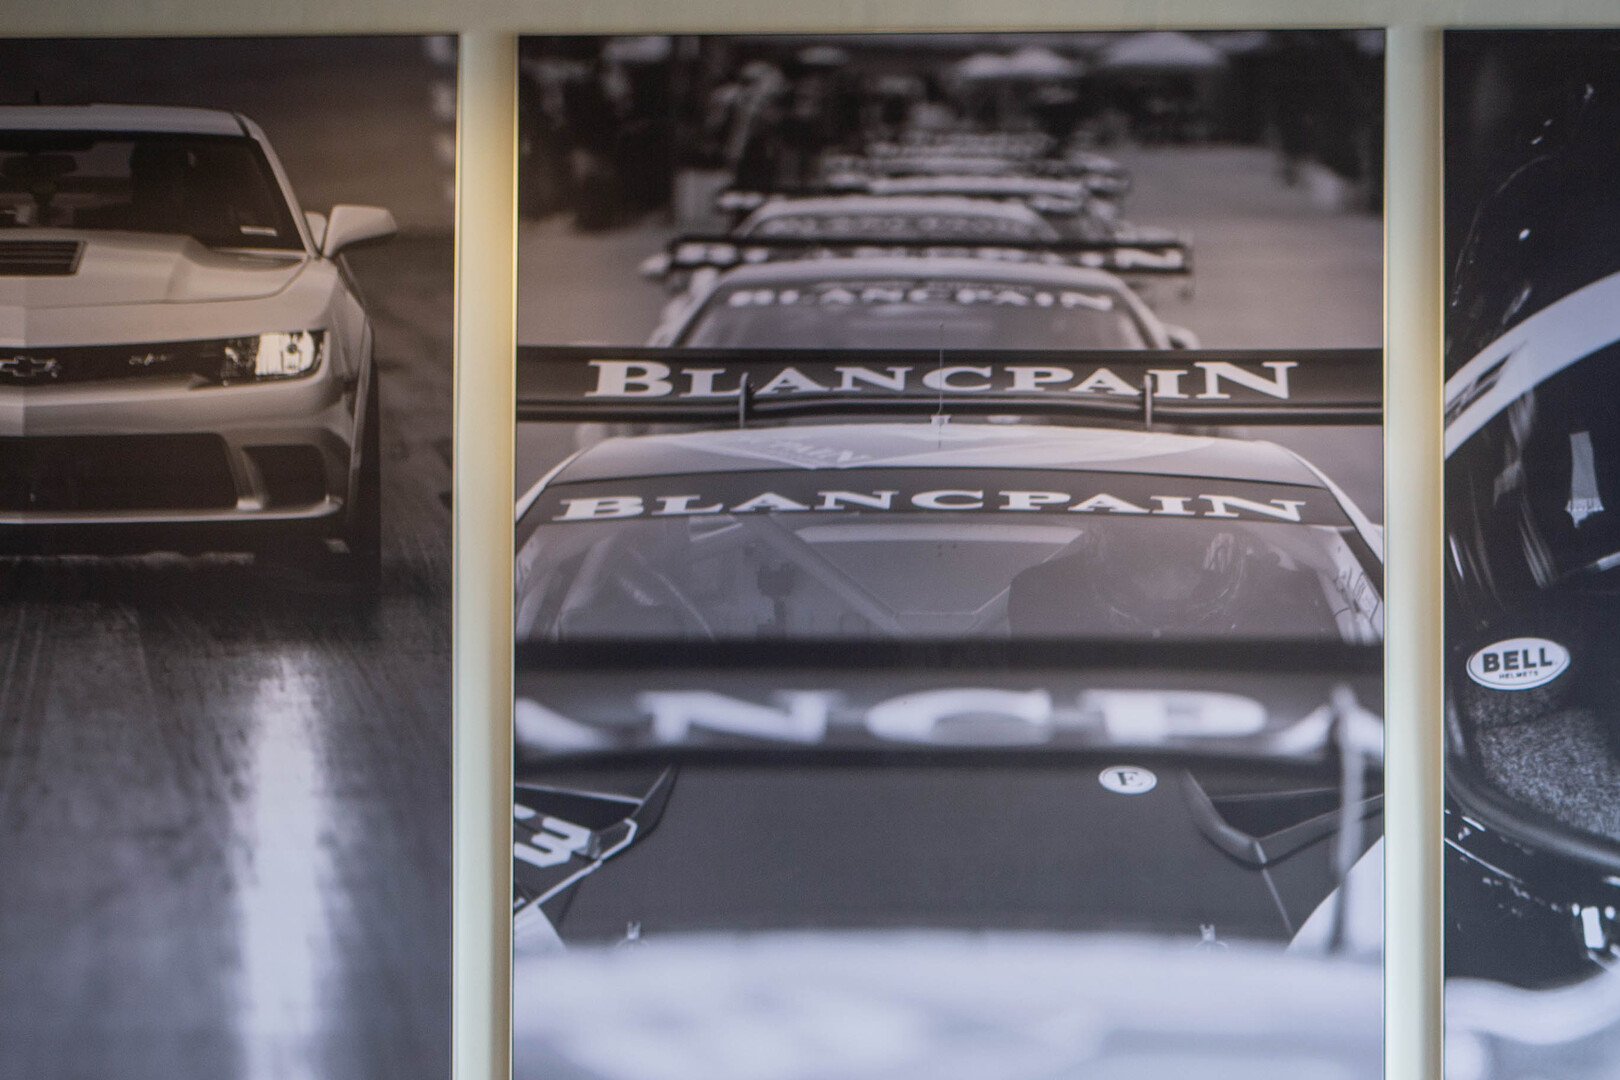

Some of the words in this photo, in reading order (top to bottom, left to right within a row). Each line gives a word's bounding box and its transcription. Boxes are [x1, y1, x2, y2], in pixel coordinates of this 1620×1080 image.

[585, 360, 1298, 400] BLANCPAIN
[552, 490, 1304, 522] BLANCPAIN
[1482, 647, 1553, 673] BELL
[1499, 670, 1538, 680] HELMETS
